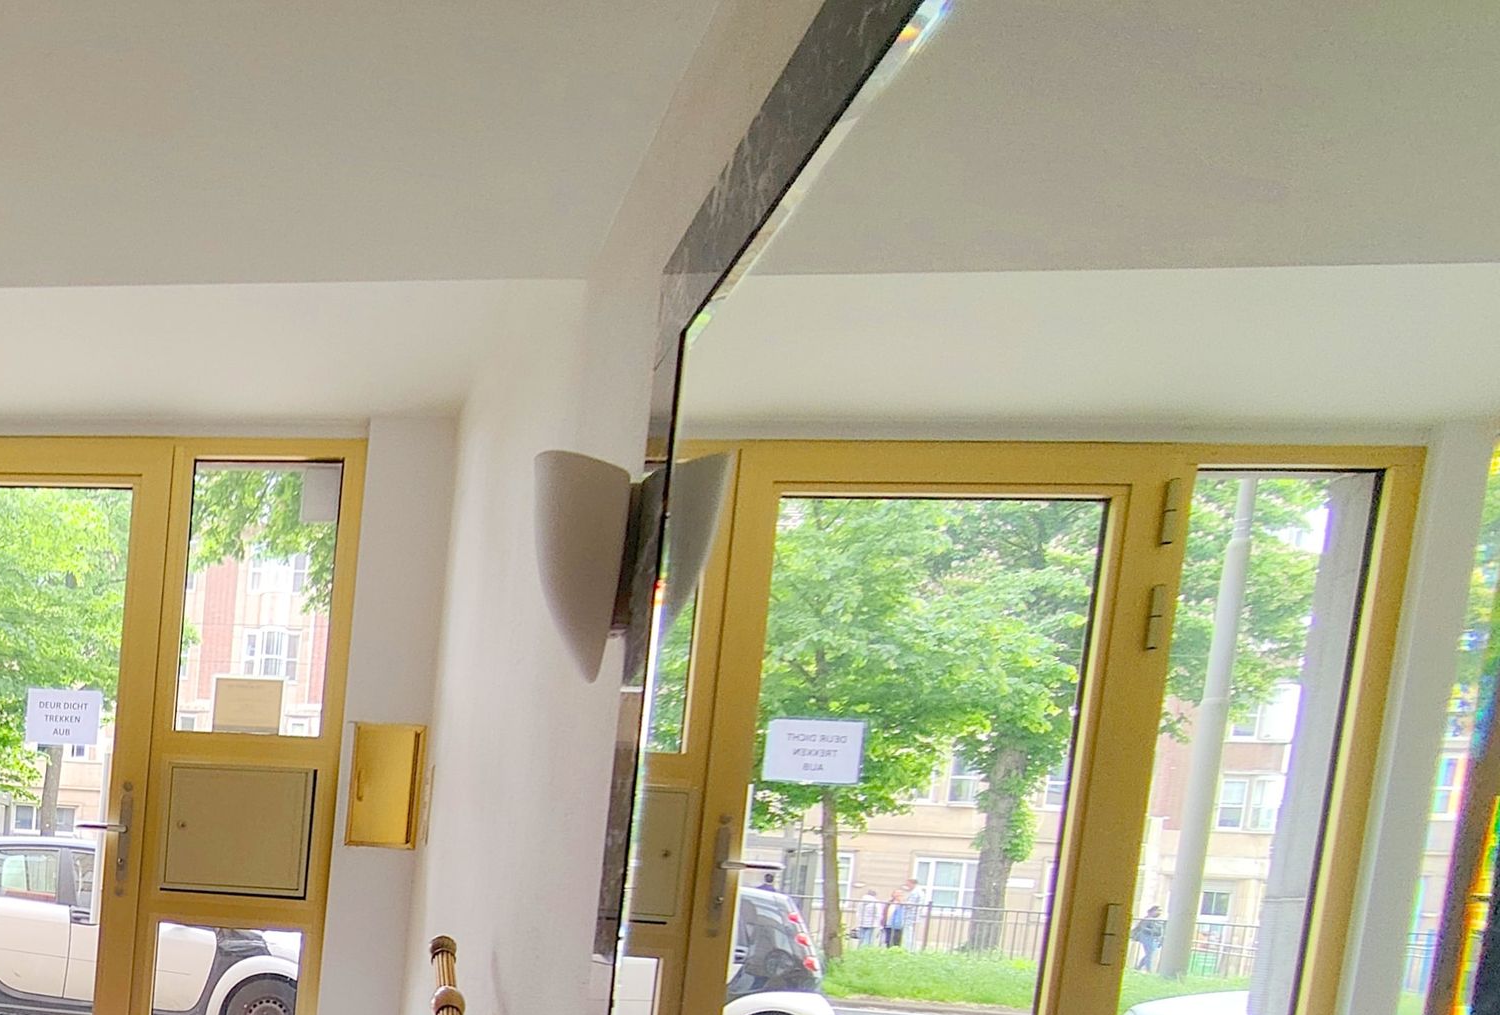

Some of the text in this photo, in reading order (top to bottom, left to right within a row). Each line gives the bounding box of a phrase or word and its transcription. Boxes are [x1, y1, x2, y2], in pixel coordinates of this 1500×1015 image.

[38, 701, 88, 711] DEUR DICHT
[44, 714, 81, 723] TREKKEN
[52, 728, 71, 736] AUB
